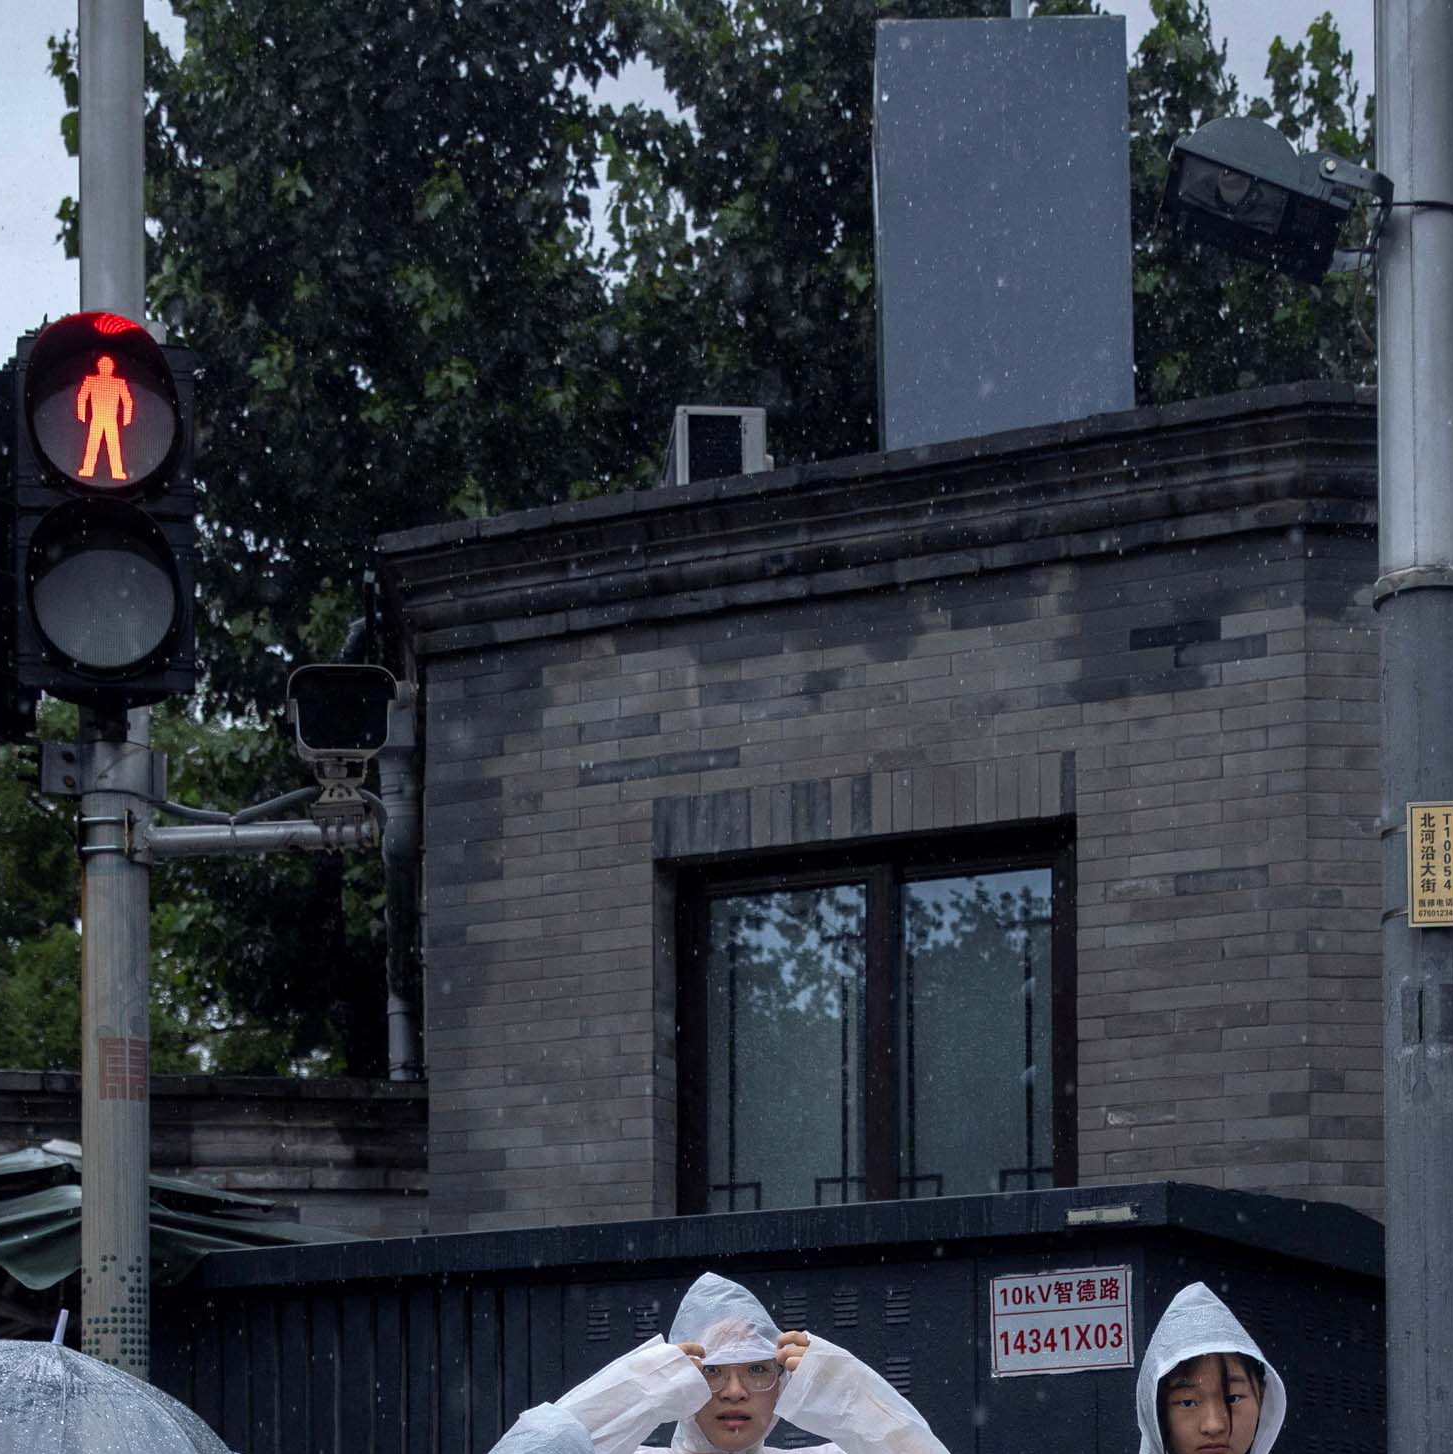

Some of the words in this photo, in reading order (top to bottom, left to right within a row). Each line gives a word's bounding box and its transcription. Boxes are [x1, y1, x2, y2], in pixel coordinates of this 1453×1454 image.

[1420, 812, 1437, 893] 北河沿大街
[1442, 813, 1452, 891] T10054
[999, 1277, 1120, 1307] 10kV智德路
[1000, 1322, 1124, 1356] 14341X03
